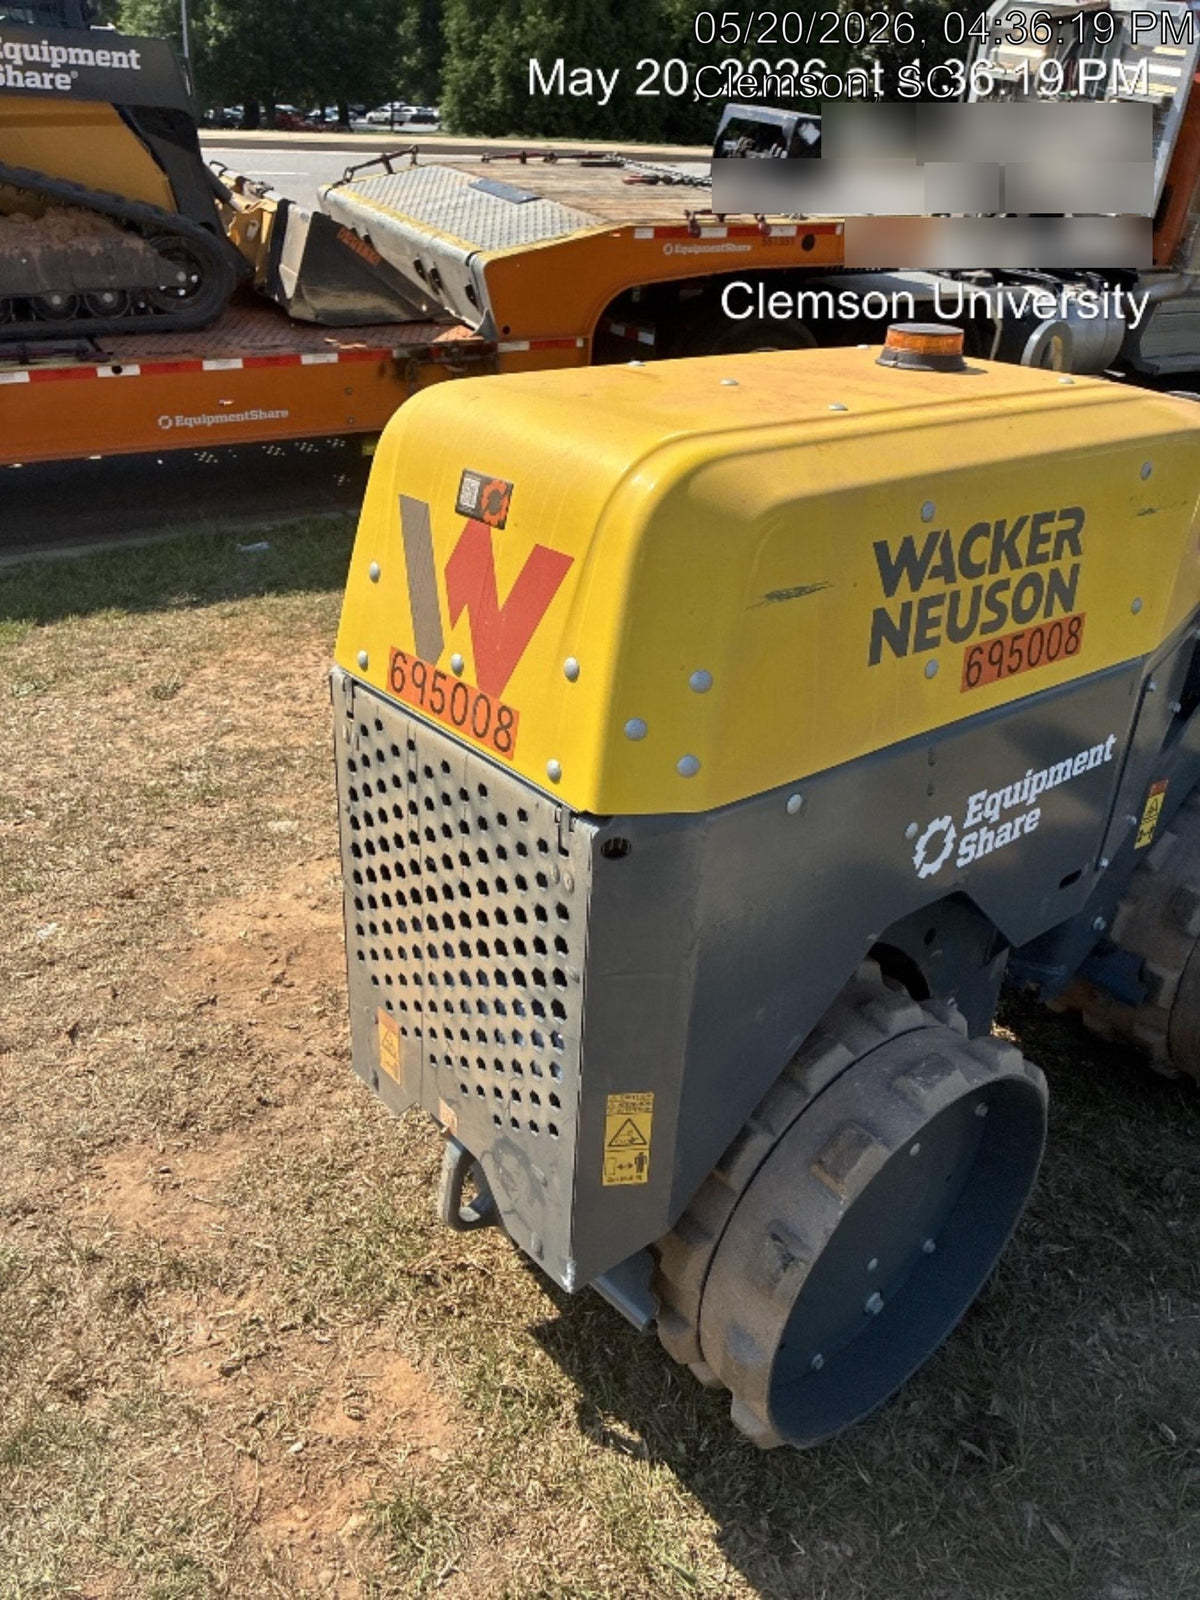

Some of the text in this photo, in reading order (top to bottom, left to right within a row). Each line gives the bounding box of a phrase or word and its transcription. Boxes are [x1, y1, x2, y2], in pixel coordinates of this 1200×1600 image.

[0, 40, 141, 70] quipment
[175, 409, 289, 427] EquipmentShare
[872, 506, 1086, 598] WACKER
[868, 563, 1081, 667] NEUSON
[966, 616, 1083, 688] 695008
[390, 651, 515, 753] 695008
[963, 733, 1118, 829] Equipment
[956, 807, 1041, 868] Share
